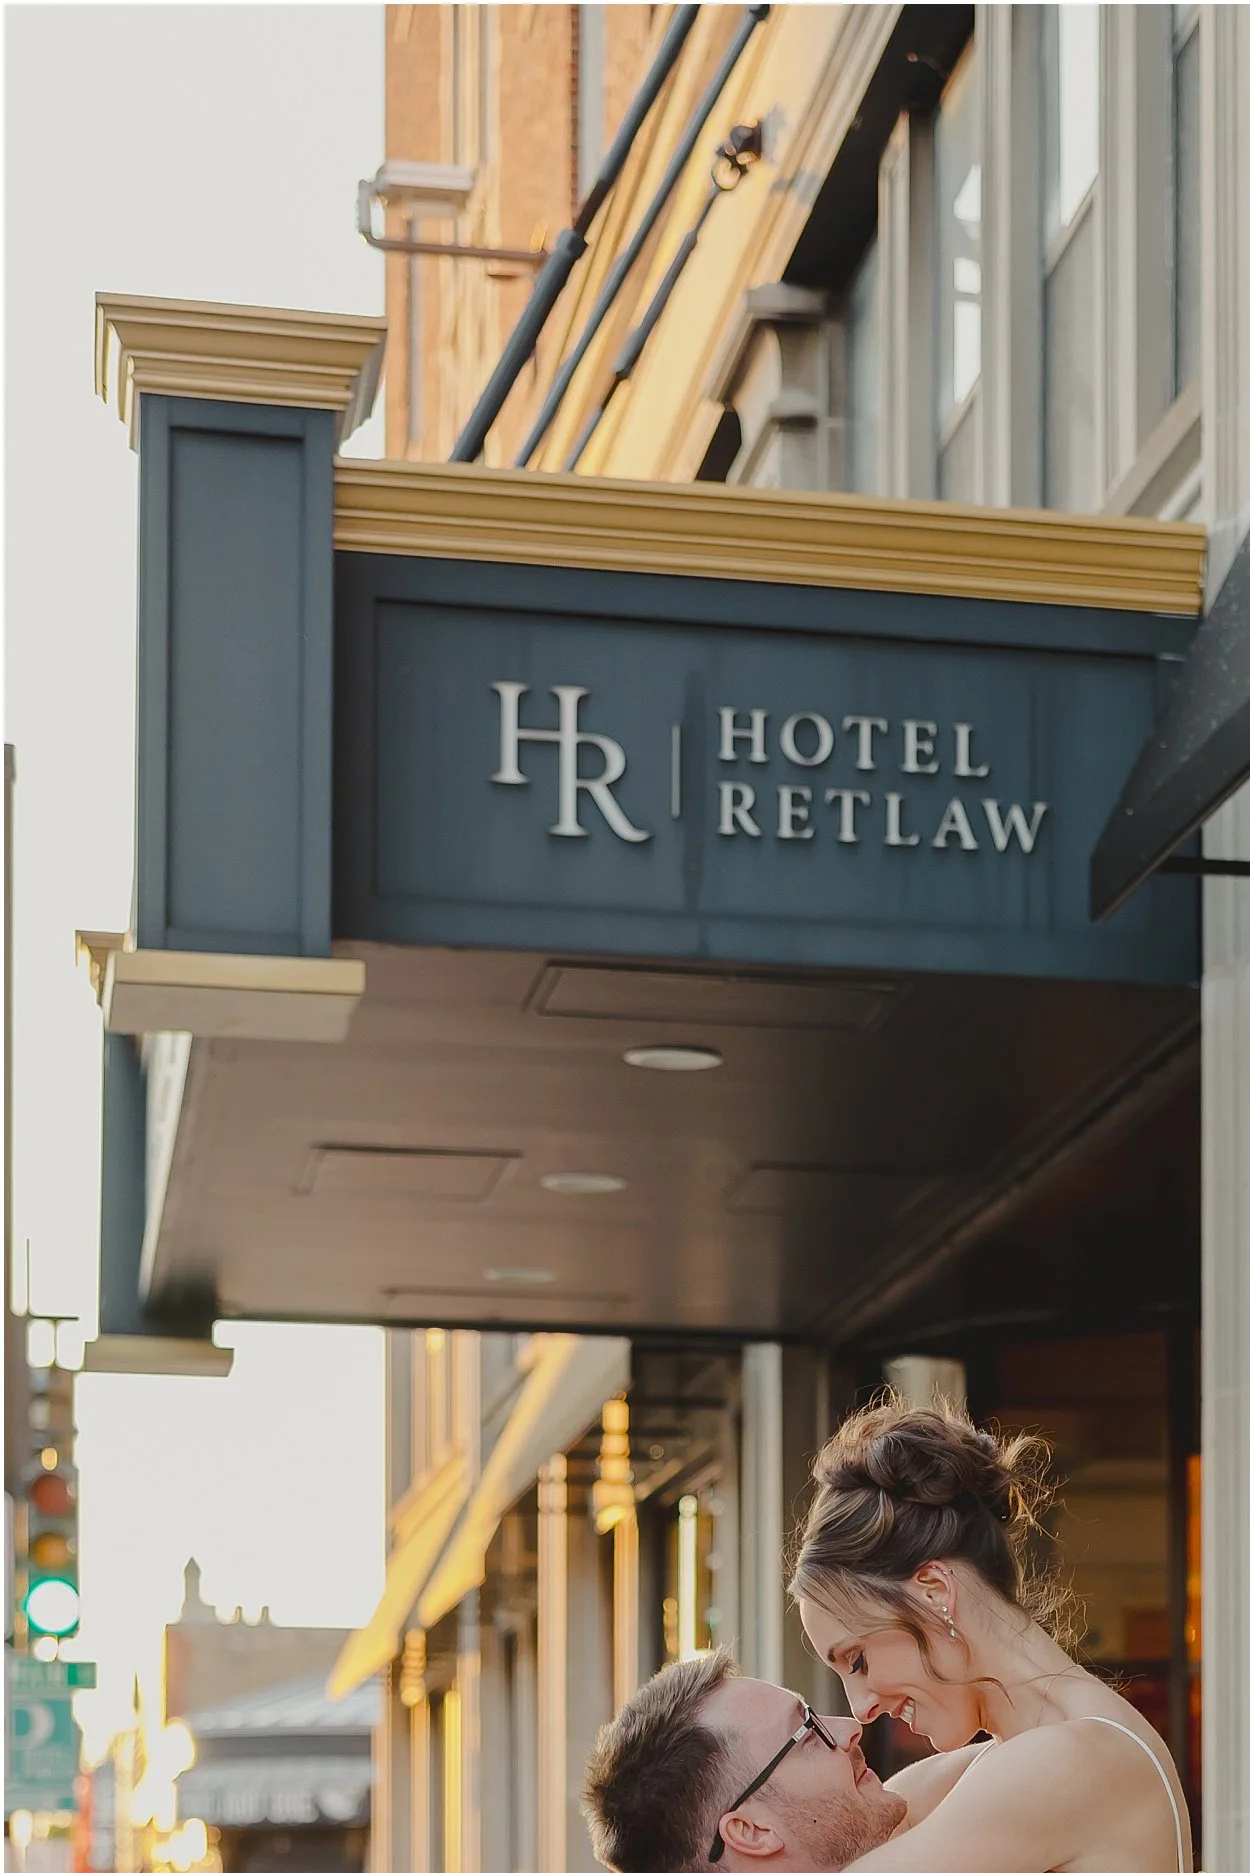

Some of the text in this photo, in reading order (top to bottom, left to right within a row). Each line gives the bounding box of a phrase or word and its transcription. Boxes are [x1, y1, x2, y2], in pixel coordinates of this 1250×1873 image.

[490, 681, 654, 843] HR
[717, 706, 990, 778] HOTEL
[717, 780, 1048, 853] RETLAW
